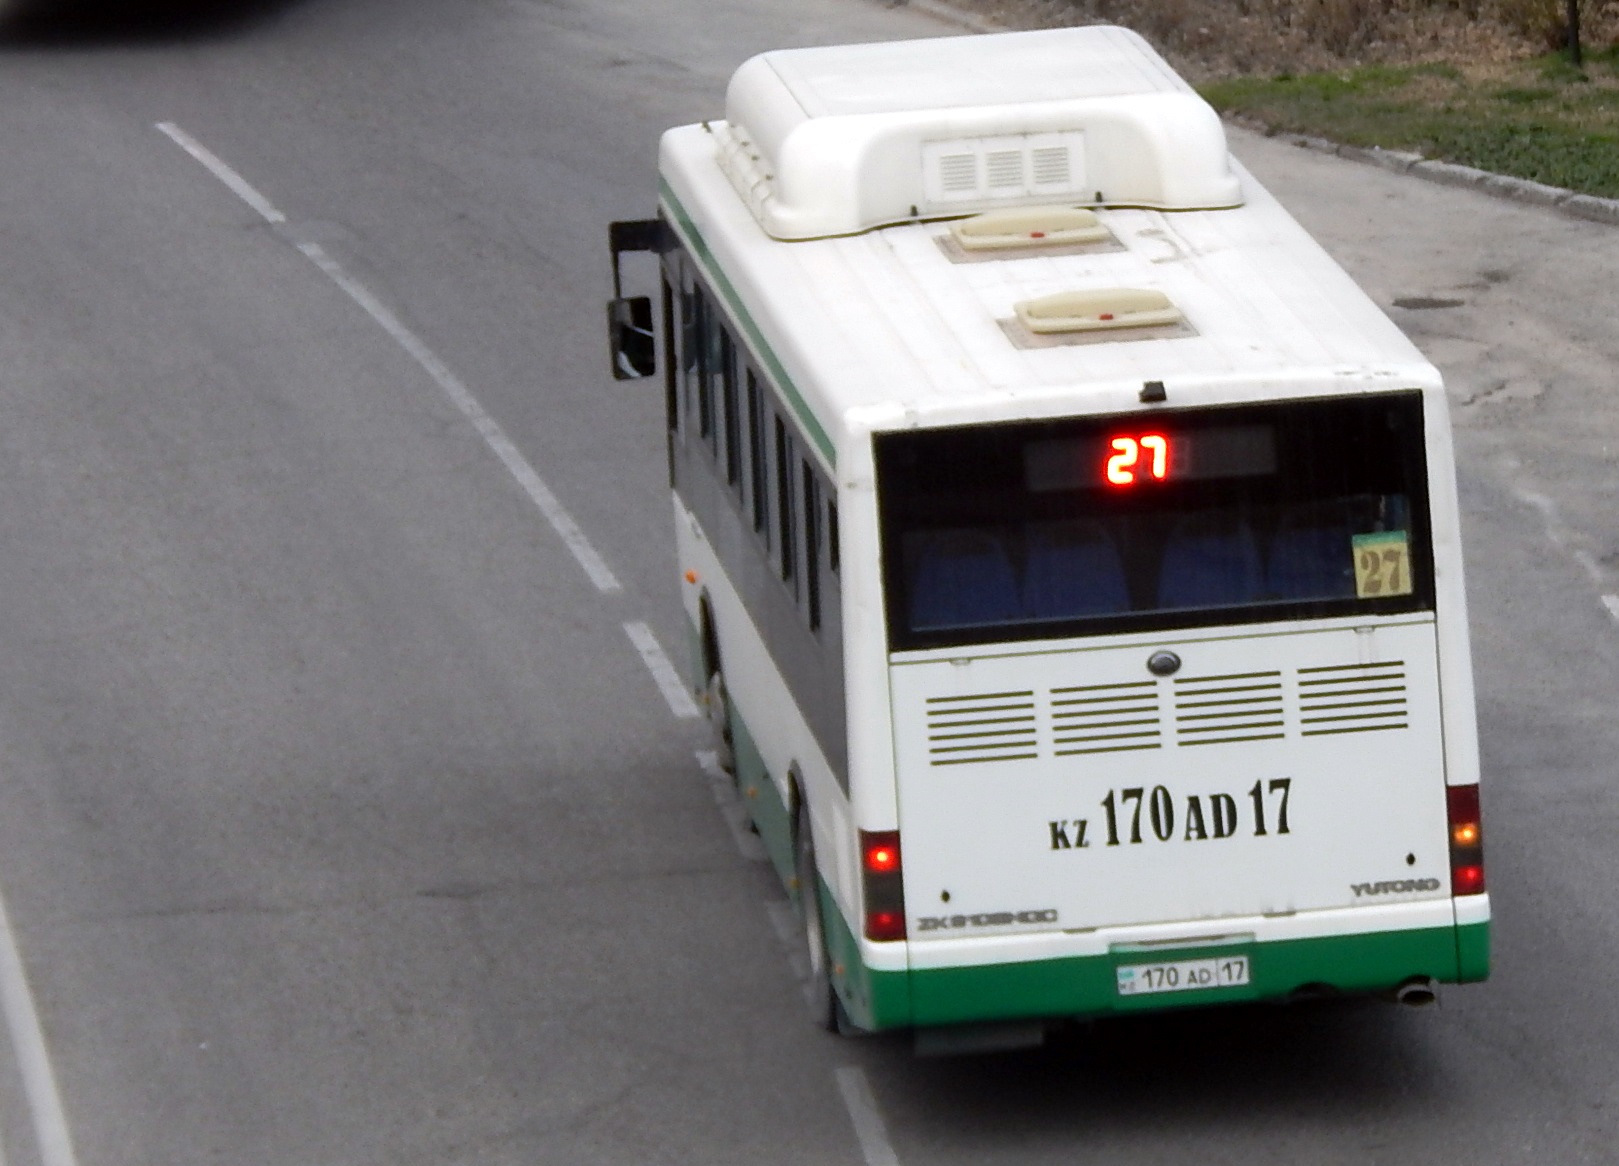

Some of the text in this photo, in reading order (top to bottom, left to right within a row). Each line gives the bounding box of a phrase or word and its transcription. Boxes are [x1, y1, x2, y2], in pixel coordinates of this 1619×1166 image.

[1106, 435, 1168, 485] 27
[1361, 549, 1401, 593] 27
[1048, 777, 1291, 850] KZ 170 AD 17
[1142, 966, 1179, 988] 170
[1187, 968, 1211, 984] AD
[1222, 961, 1244, 981] 17
